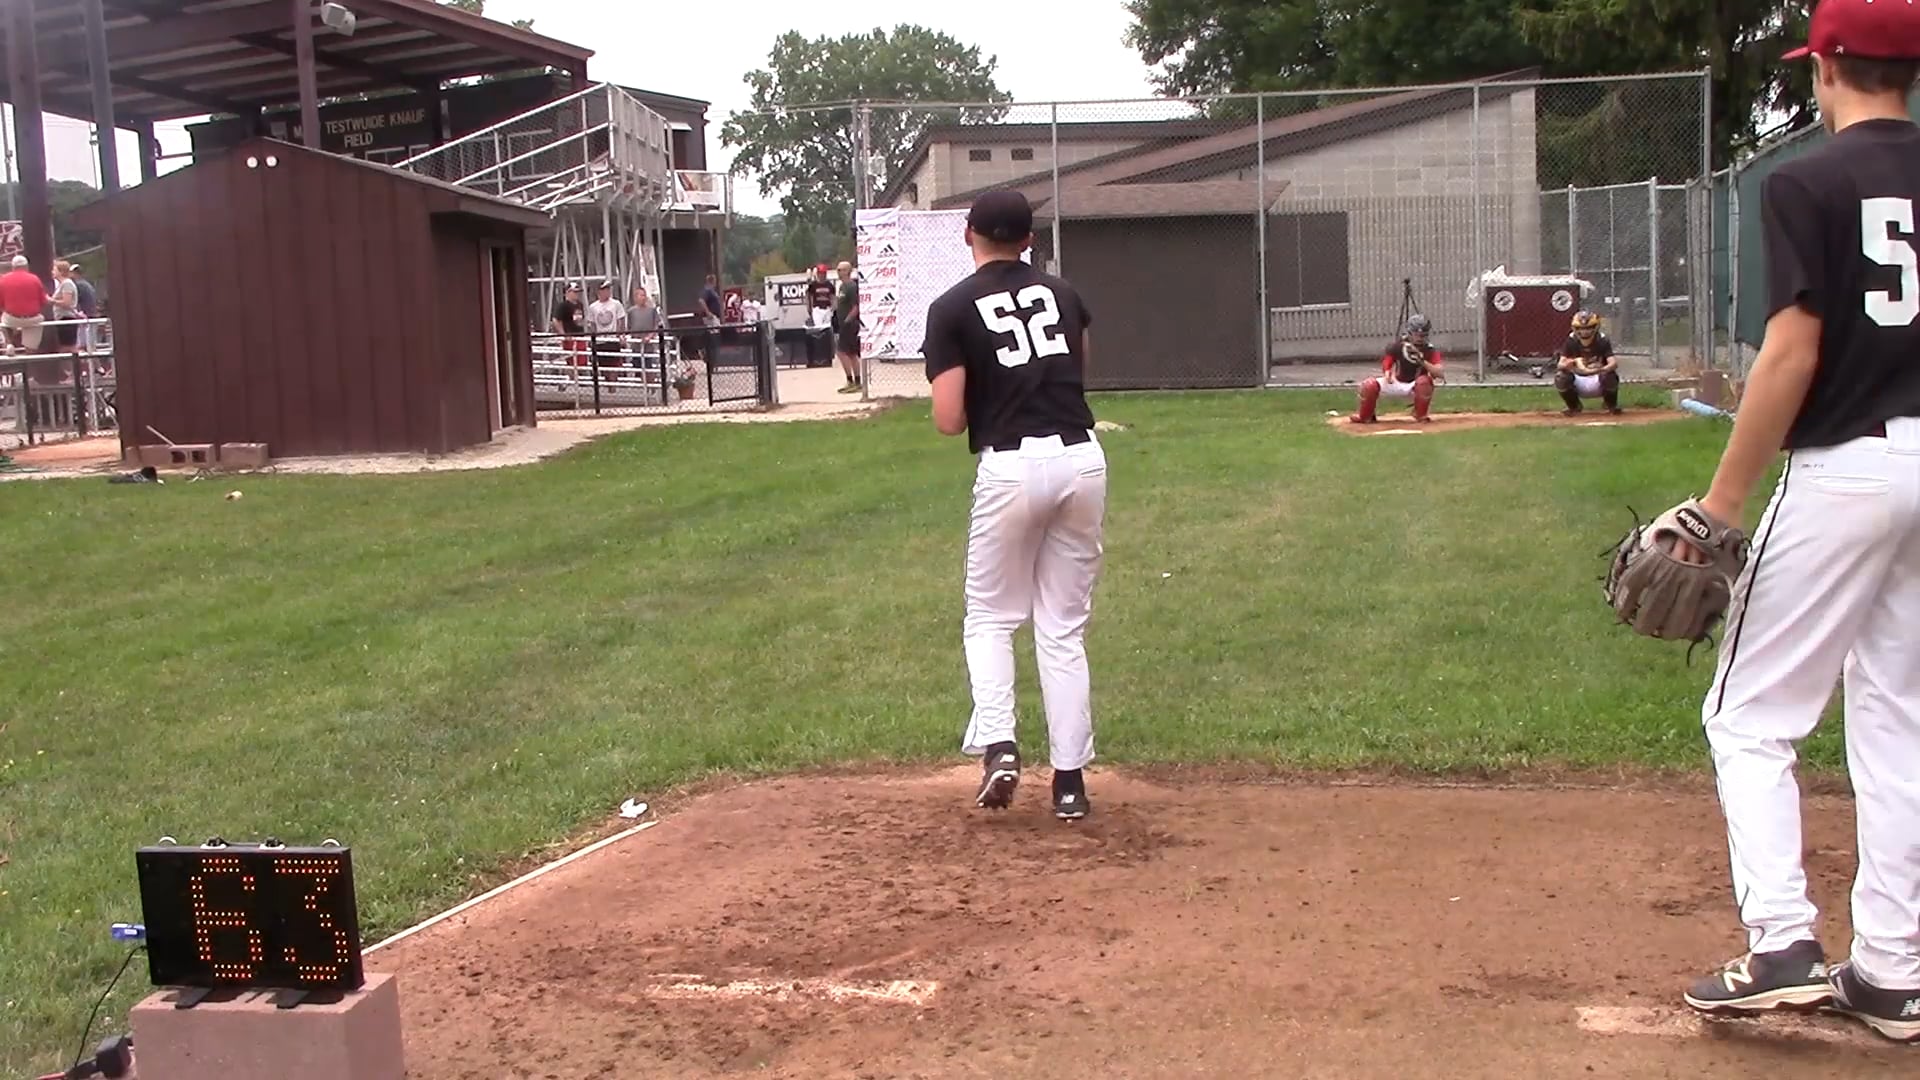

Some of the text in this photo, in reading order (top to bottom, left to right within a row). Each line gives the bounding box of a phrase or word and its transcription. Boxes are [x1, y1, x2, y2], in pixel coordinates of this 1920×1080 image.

[324, 114, 384, 134] TESTWUIDE
[389, 108, 424, 126] KNAUF
[344, 132, 373, 147] FIELD
[1861, 197, 1920, 326] 5
[782, 285, 809, 298] KOH
[975, 284, 1070, 368] 52
[191, 859, 348, 980] 63
